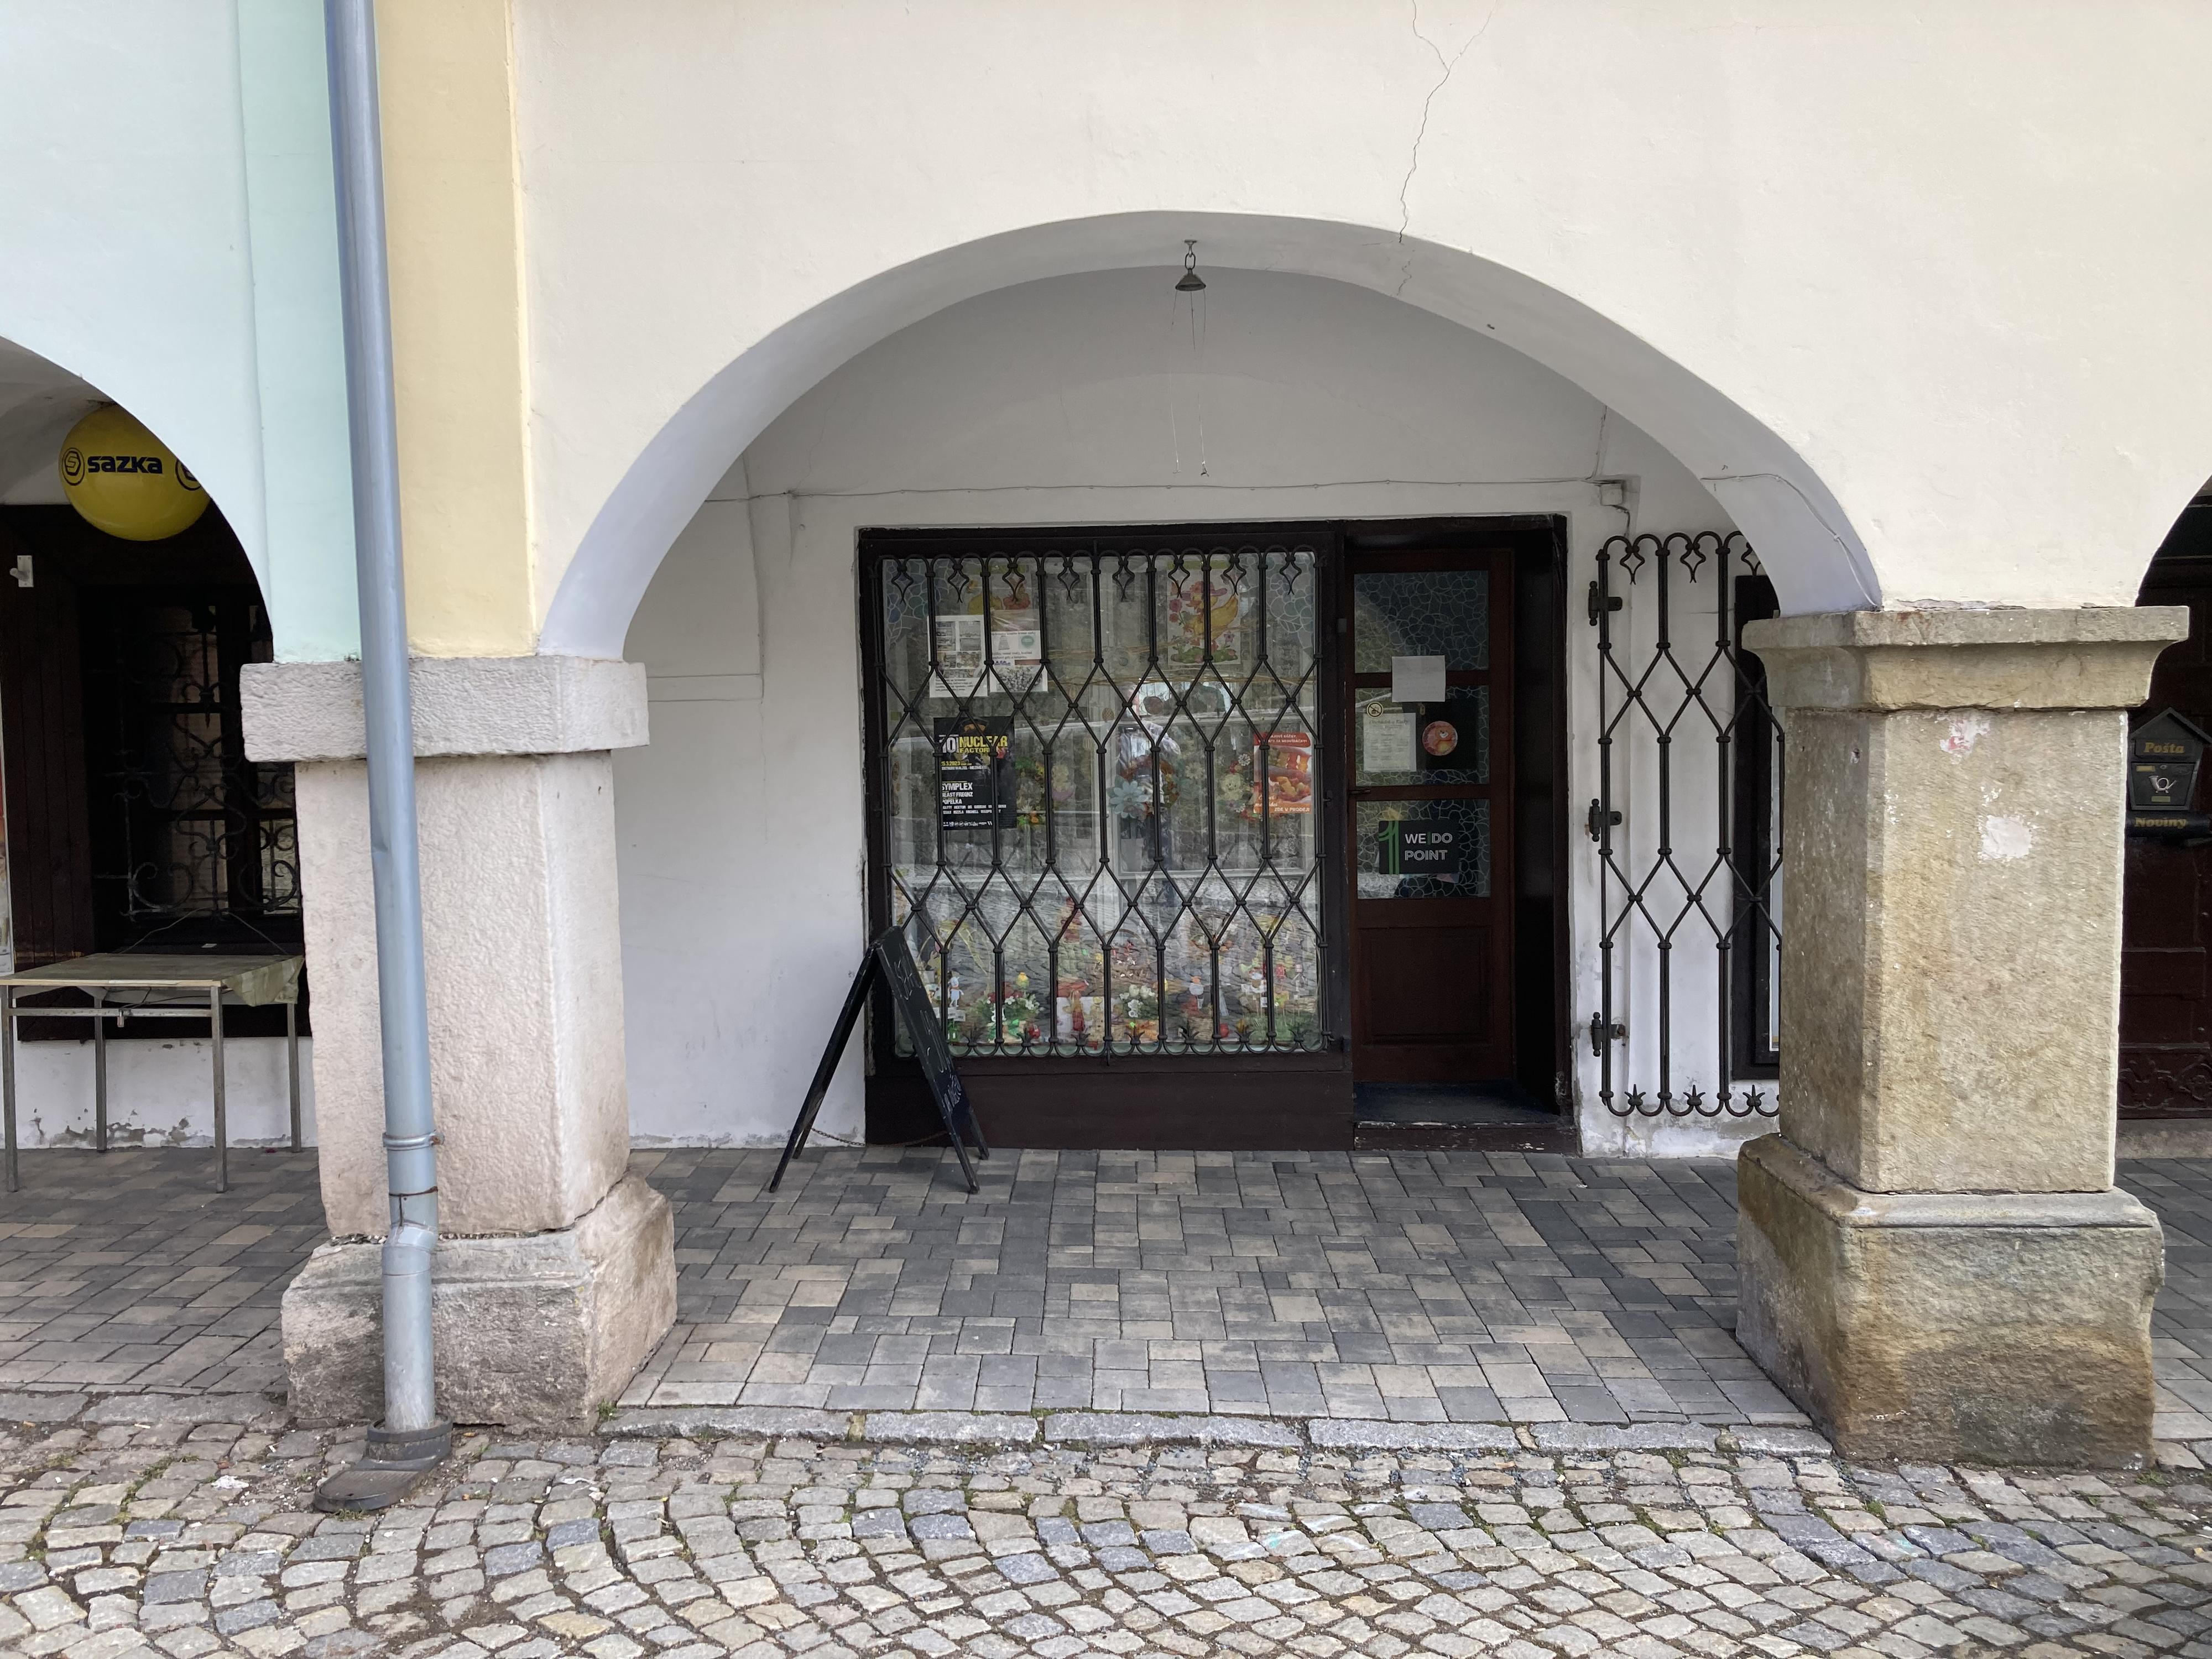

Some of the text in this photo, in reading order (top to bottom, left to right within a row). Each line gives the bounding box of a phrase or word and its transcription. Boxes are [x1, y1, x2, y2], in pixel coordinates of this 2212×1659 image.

[2144, 742, 2185, 753] Pošta
[2135, 817, 2187, 828] Noviny
[1405, 849, 1448, 860] POINT
